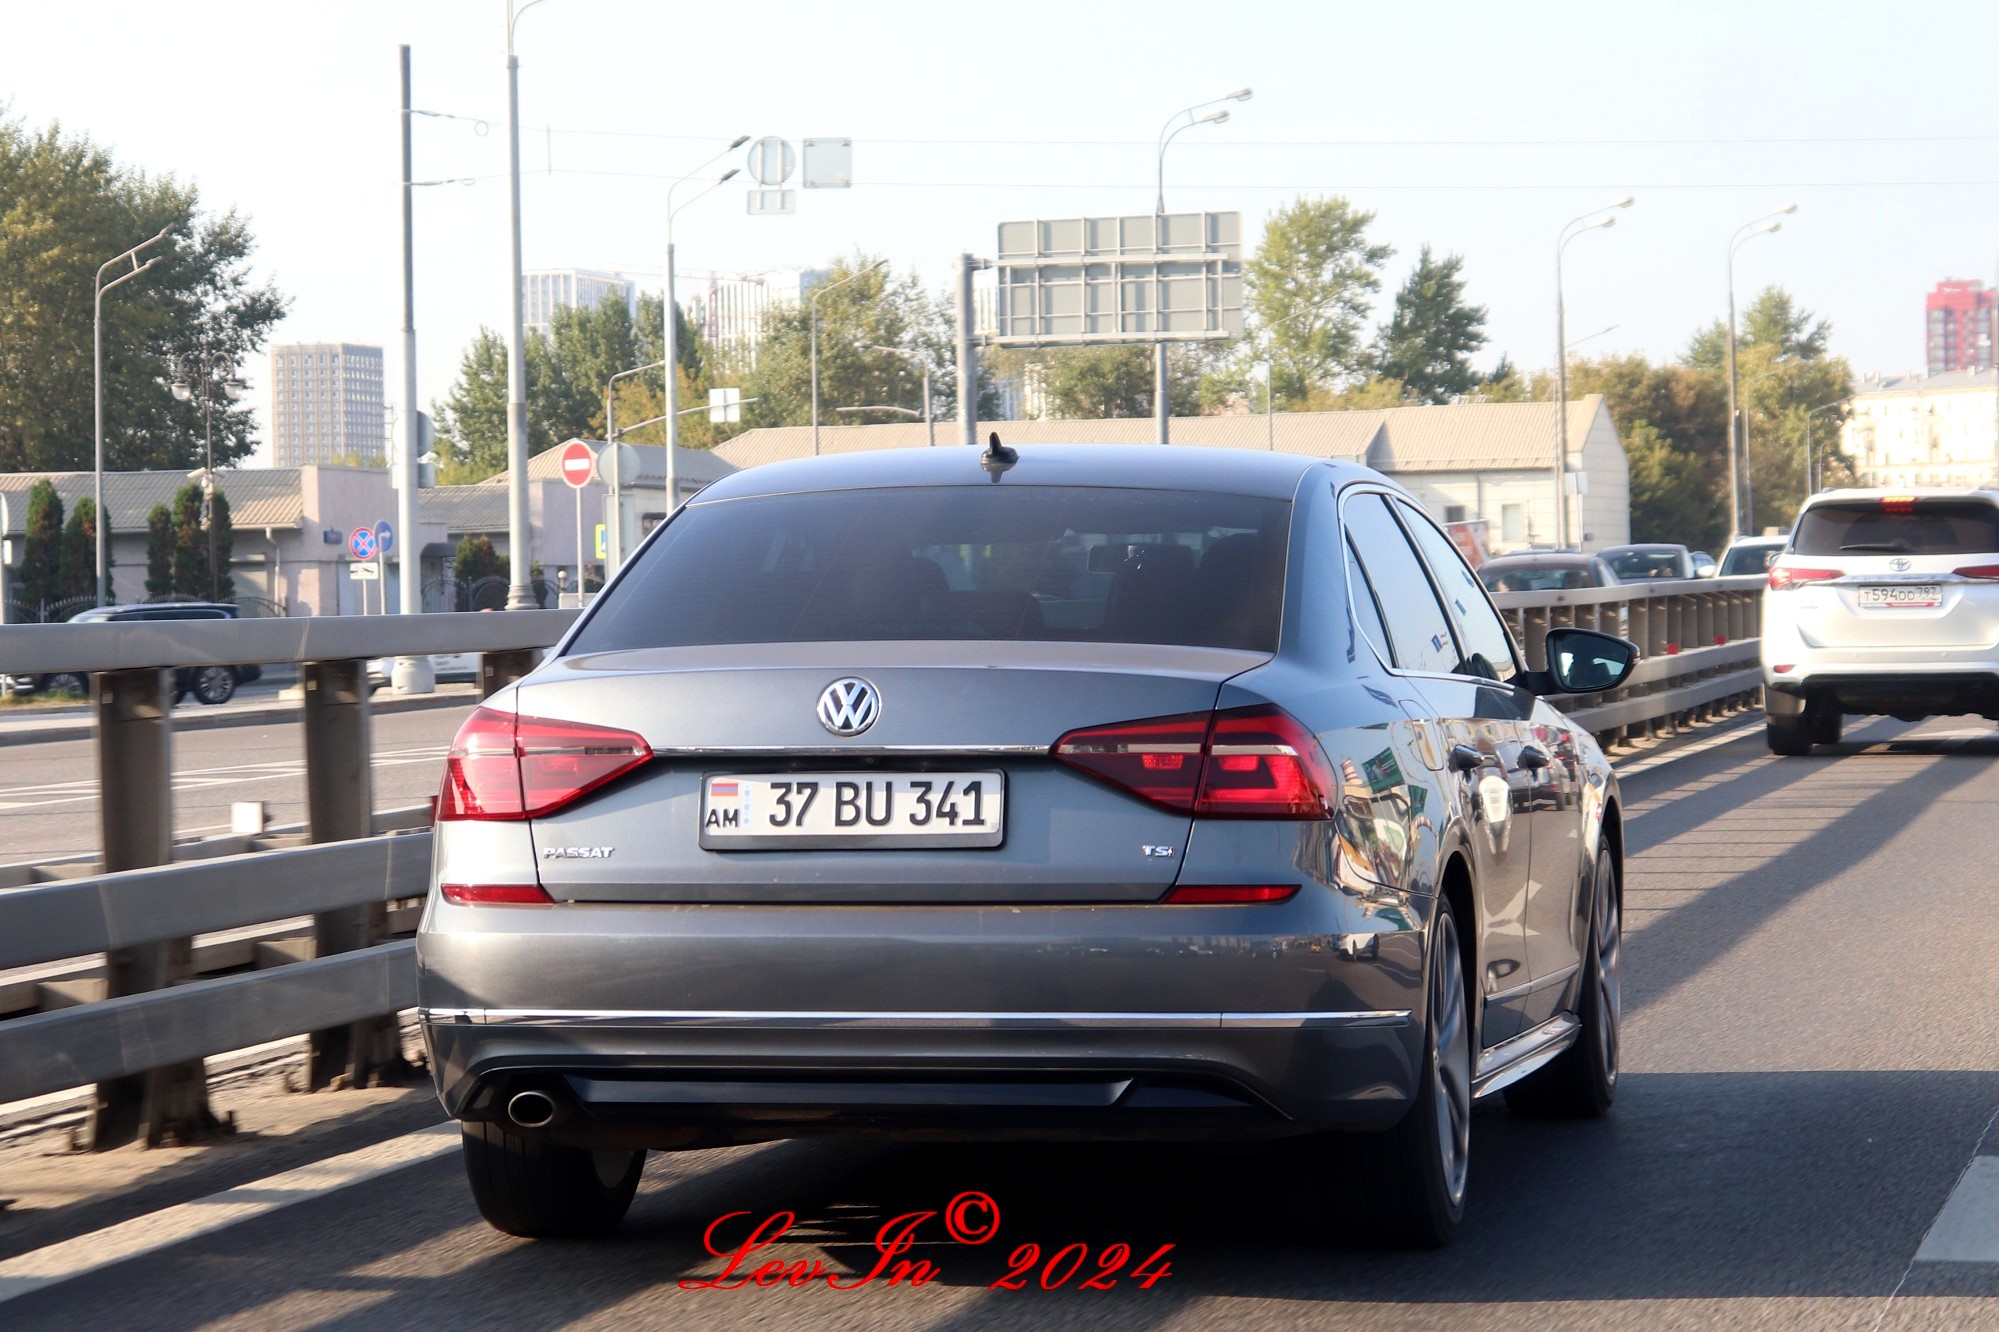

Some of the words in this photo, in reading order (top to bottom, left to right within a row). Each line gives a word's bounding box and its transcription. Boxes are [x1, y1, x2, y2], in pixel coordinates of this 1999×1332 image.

[769, 782, 818, 827] 37
[834, 781, 893, 827] BU
[909, 781, 985, 826] 341
[705, 808, 739, 828] AM
[543, 847, 614, 859] PASSAT
